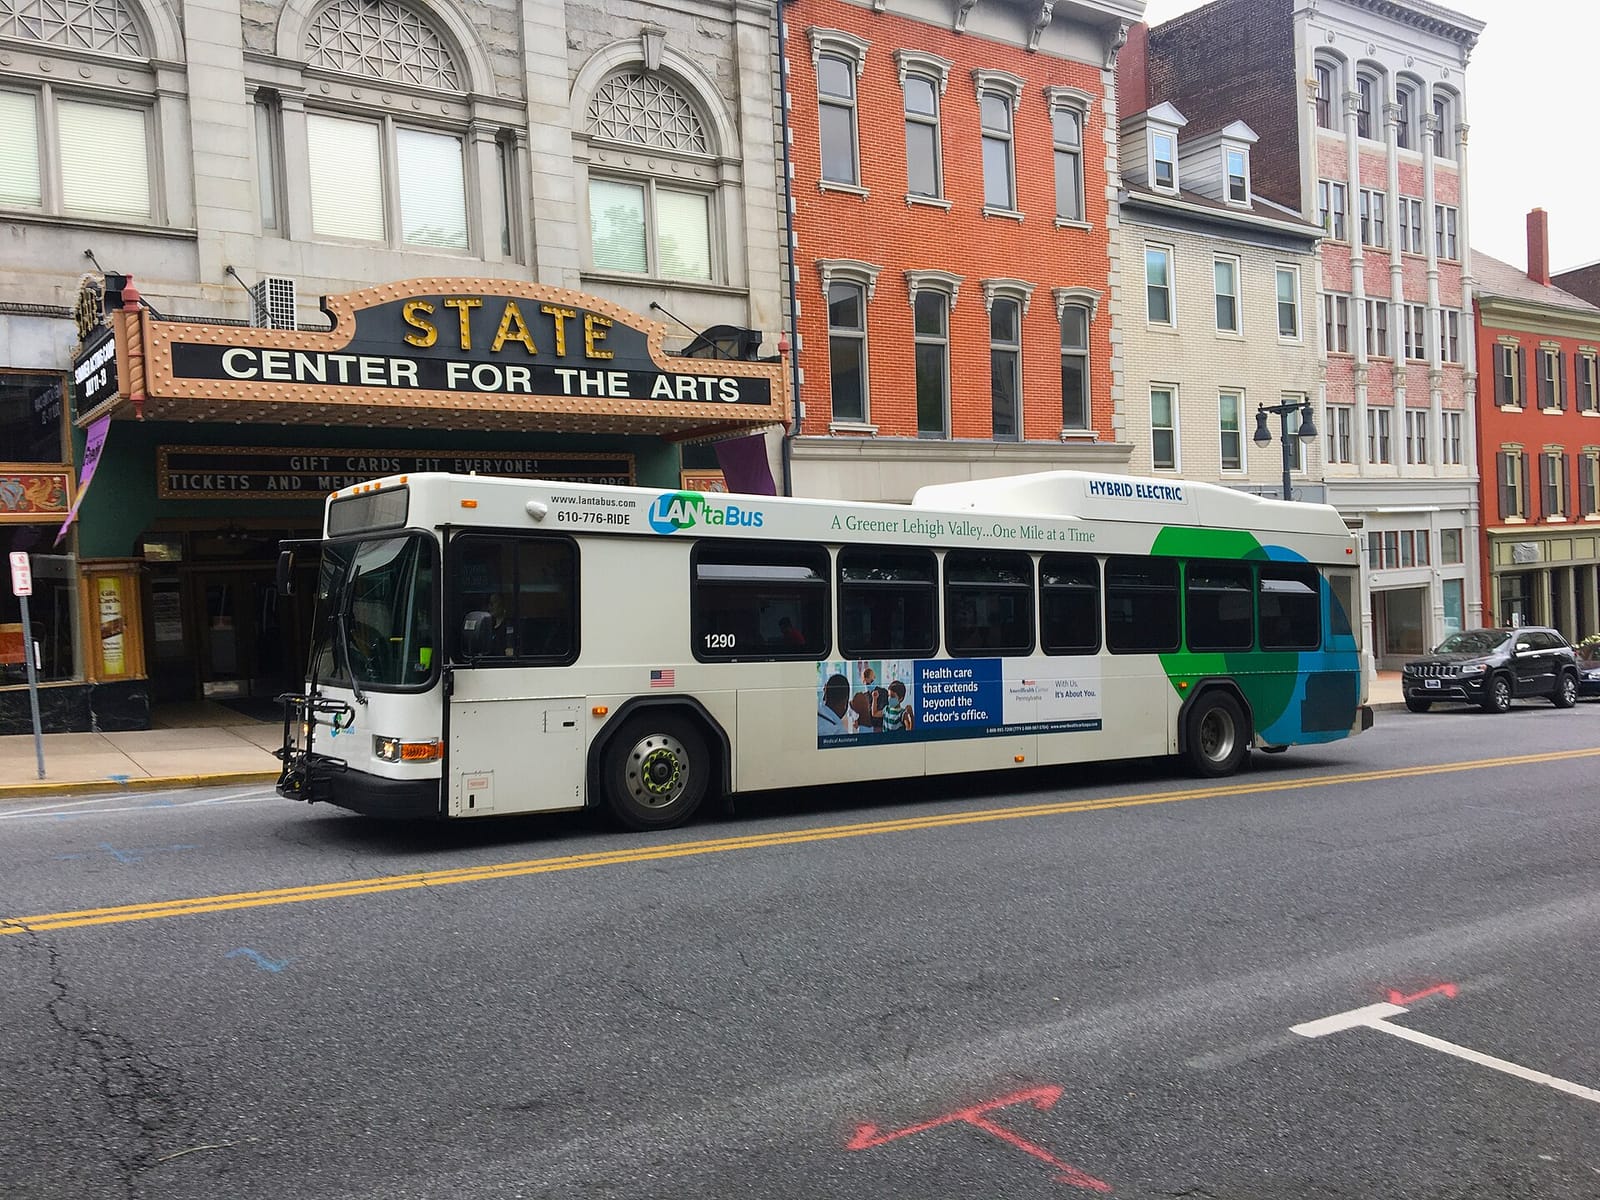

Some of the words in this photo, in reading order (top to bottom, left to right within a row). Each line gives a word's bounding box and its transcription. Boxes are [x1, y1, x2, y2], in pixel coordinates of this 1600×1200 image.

[402, 297, 614, 360] STATE
[221, 348, 419, 387] CENTER
[447, 362, 532, 393] FOR
[554, 369, 630, 398] THE
[650, 374, 740, 402] ARTS
[290, 456, 330, 471] GIFT
[346, 457, 401, 472] CARDS
[416, 458, 441, 472] FIT
[455, 458, 539, 473] EVERYONE!
[169, 474, 250, 490] TICKETS
[267, 476, 301, 490] AND
[1089, 480, 1133, 497] HYBRID
[1136, 484, 1183, 501] ELECTRIC
[551, 494, 636, 508] www.lantabus.com
[557, 511, 630, 525] 610-776-RIDE
[652, 498, 764, 528] LANtaBus
[831, 515, 842, 530] A
[845, 515, 899, 533] Greener
[902, 518, 945, 539] Lehigh
[1020, 525, 1044, 540] Mile
[1046, 530, 1057, 541] at
[1059, 531, 1065, 541] a
[1068, 527, 1096, 543] Time
[704, 634, 736, 648] 1290
[922, 667, 952, 679] Health
[953, 668, 973, 678] care
[922, 682, 942, 694] that
[943, 680, 979, 693] extends
[1054, 679, 1070, 688] With
[1055, 690, 1064, 699] It's
[1064, 690, 1083, 699] About
[1083, 689, 1096, 697] You.
[922, 695, 956, 710] beyond
[957, 695, 973, 707] the
[922, 710, 960, 723] doctor's
[961, 709, 989, 721] office.
